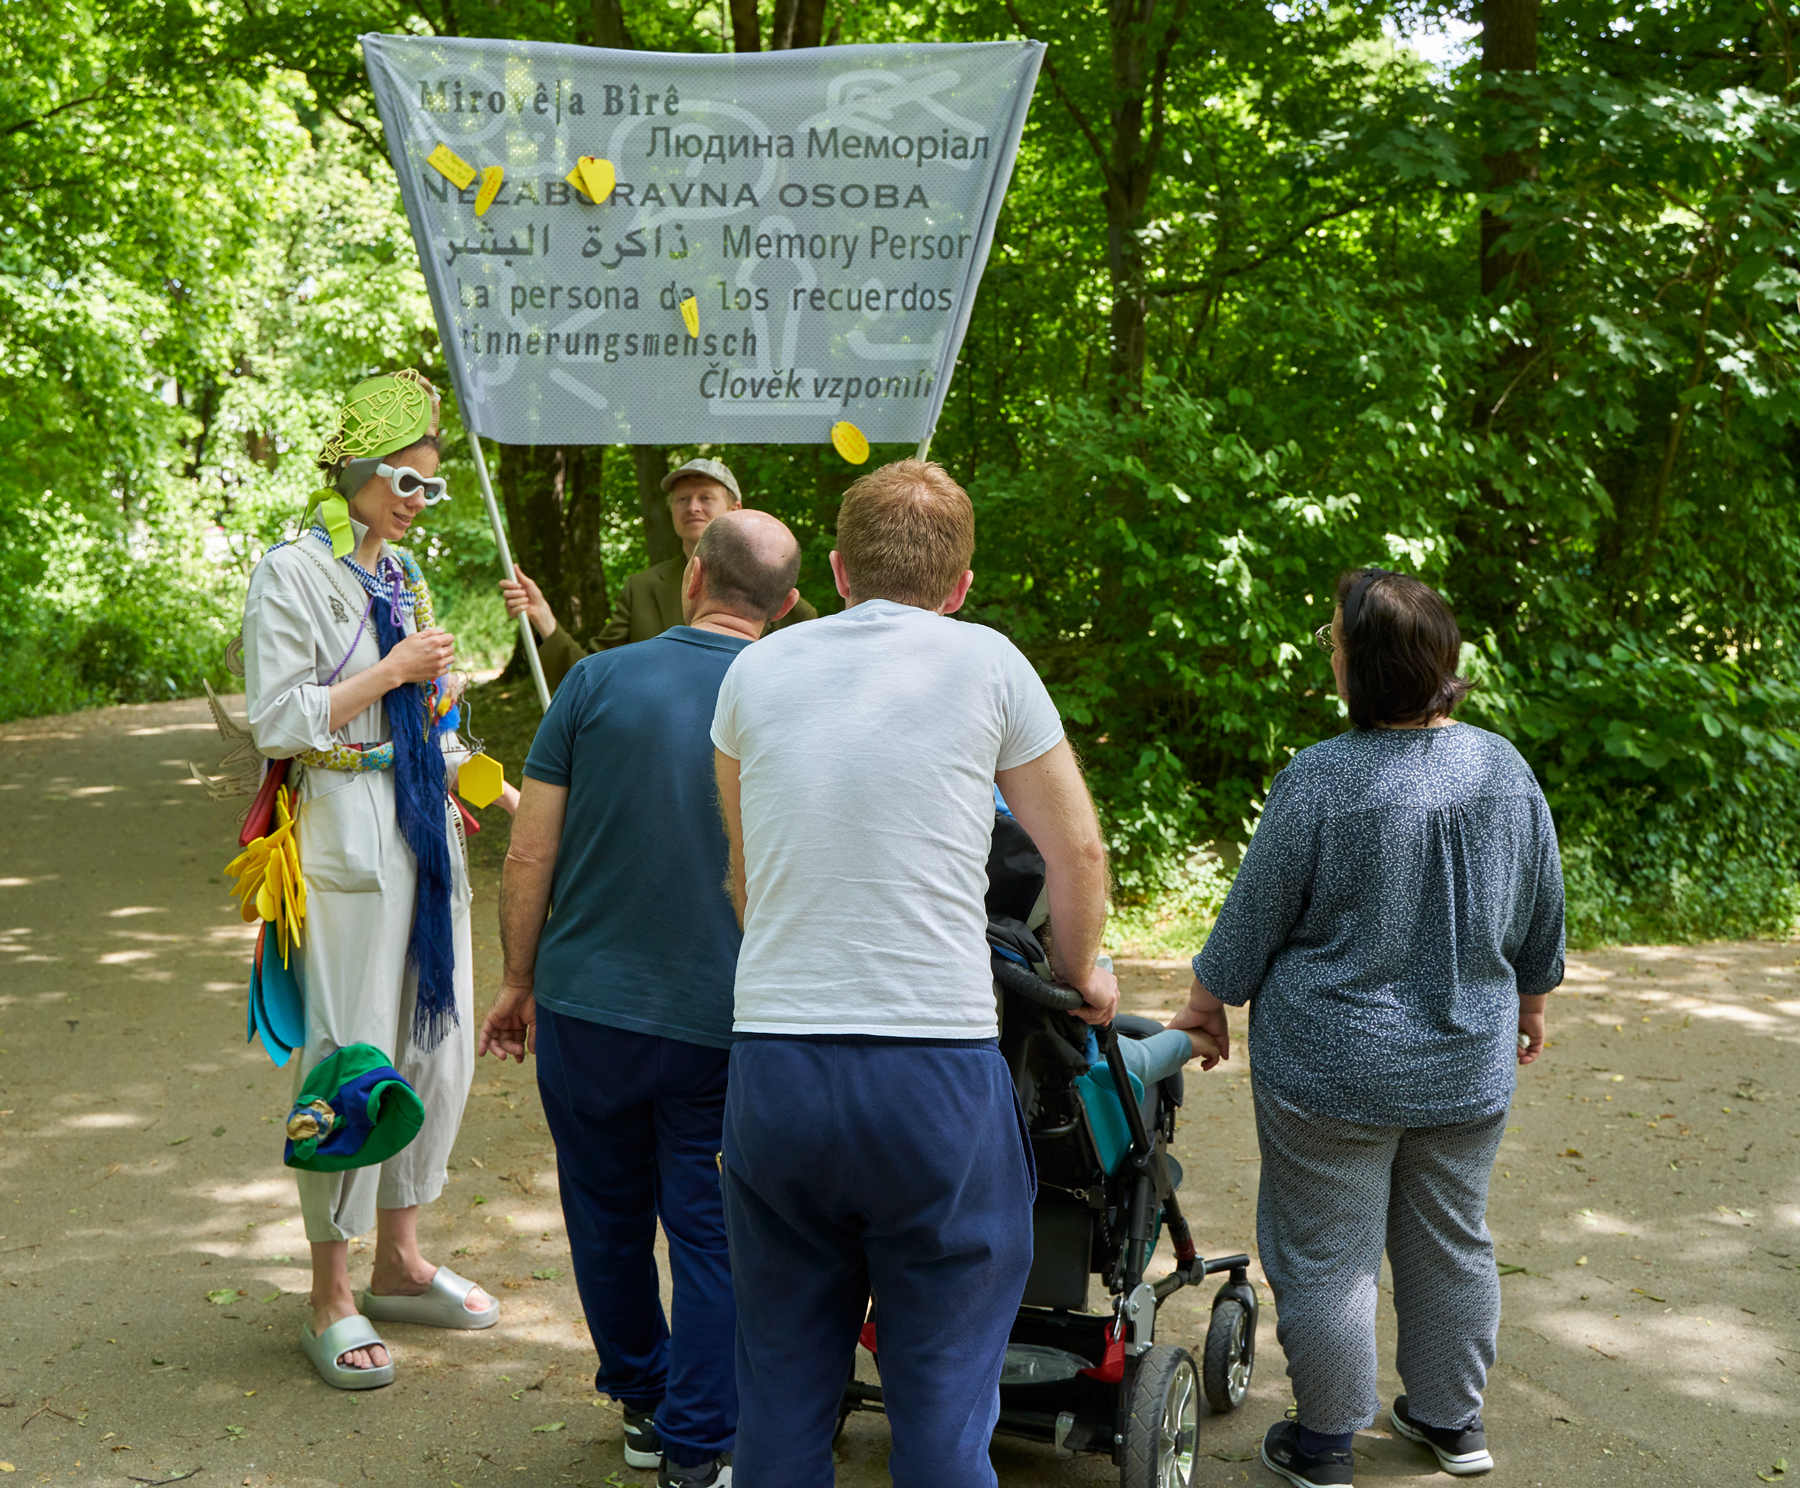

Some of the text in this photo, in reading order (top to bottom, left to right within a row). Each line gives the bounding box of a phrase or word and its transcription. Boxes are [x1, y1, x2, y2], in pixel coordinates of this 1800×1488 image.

[603, 83, 680, 116] Bîrê
[647, 126, 990, 168] Людина Меморіал
[778, 183, 930, 209] OSOBA
[581, 223, 689, 270] ذاكرة
[722, 225, 859, 270] Memory
[511, 284, 639, 317] persona
[717, 280, 769, 312] los
[793, 282, 953, 312] recuerdos
[700, 362, 801, 400] Člověk
